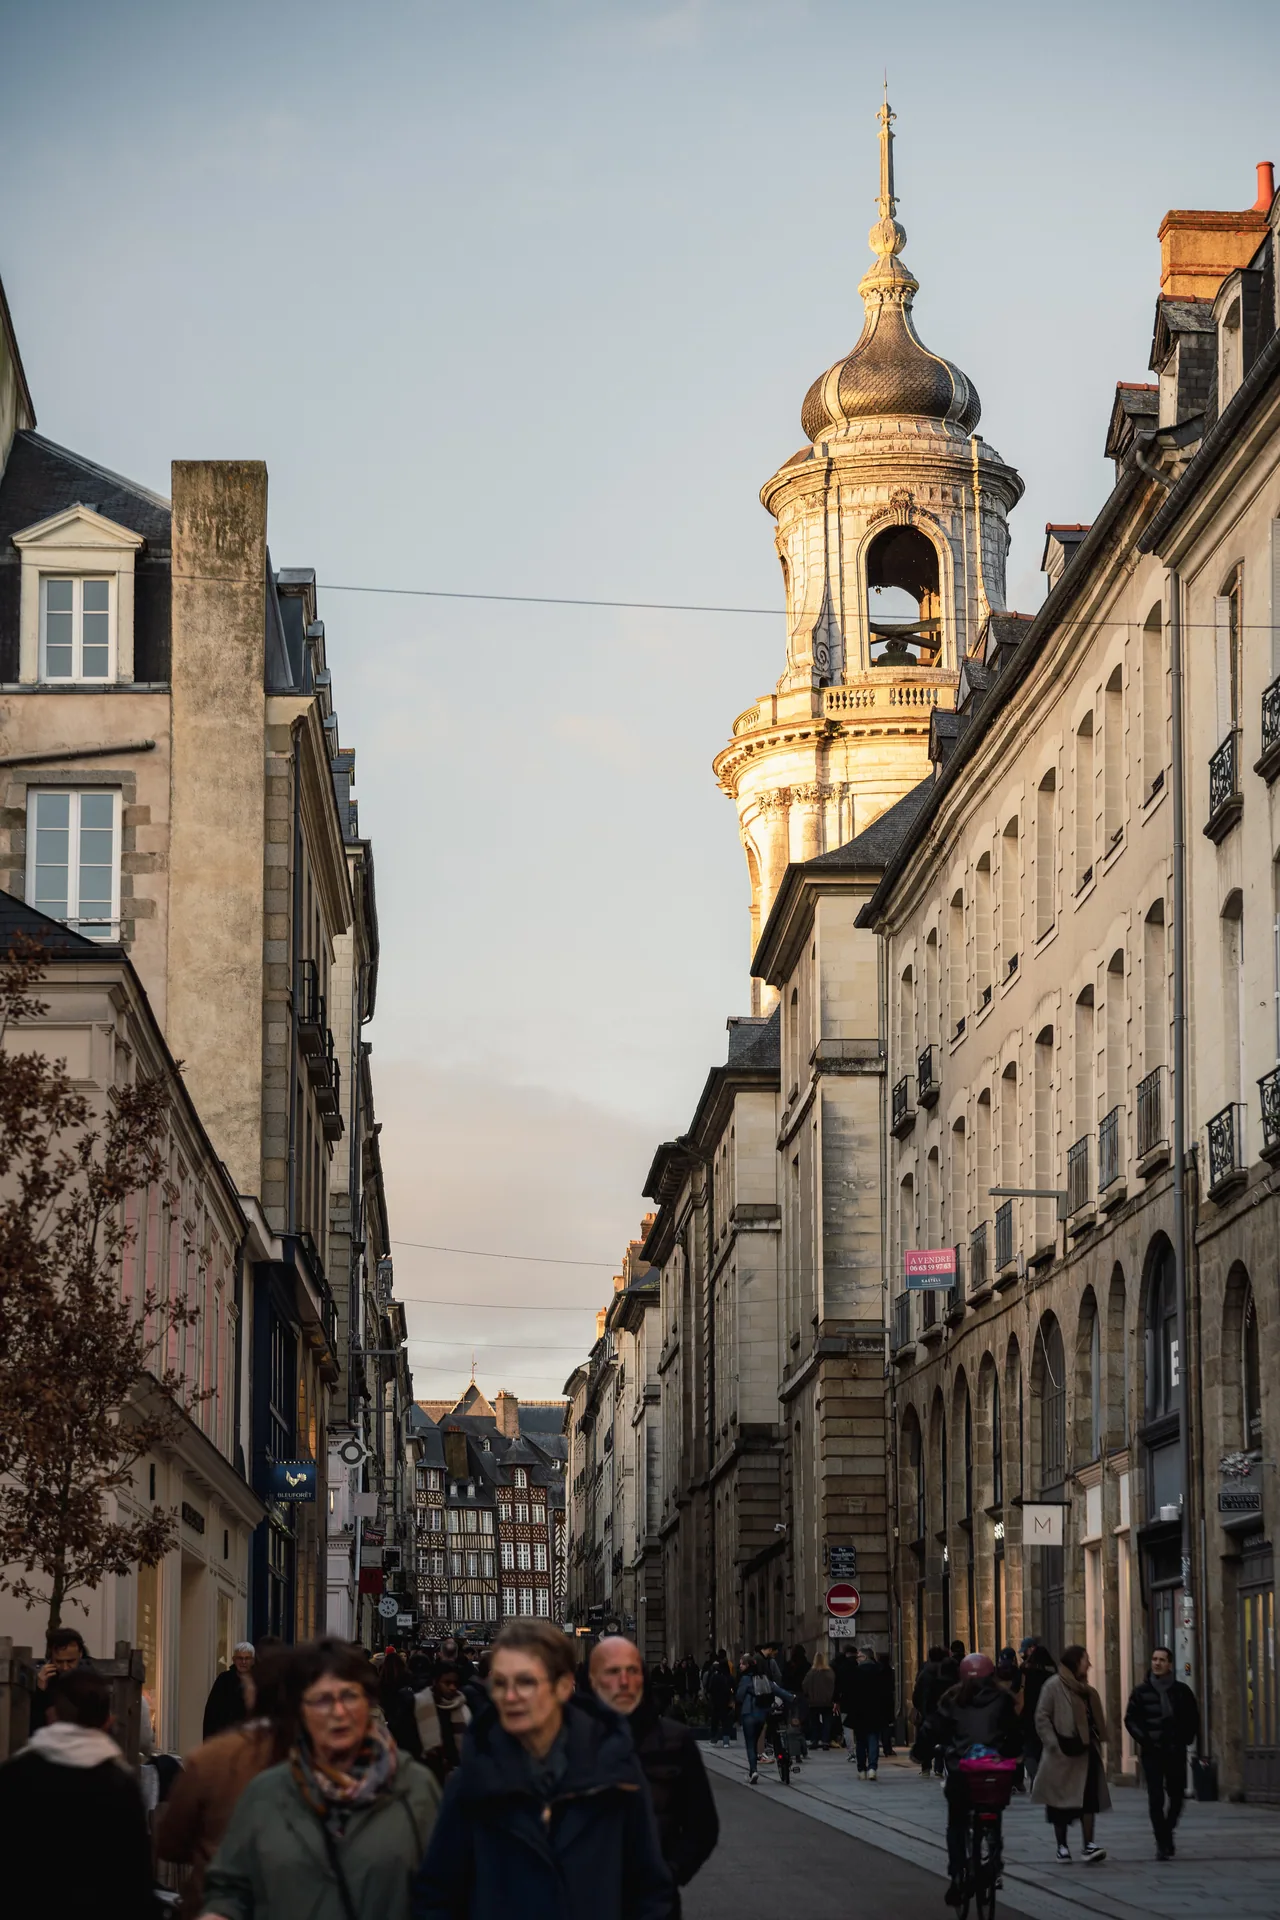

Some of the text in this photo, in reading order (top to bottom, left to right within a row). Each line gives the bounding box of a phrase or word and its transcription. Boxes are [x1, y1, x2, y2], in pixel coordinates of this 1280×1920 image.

[910, 1255, 951, 1265] A VENDRE
[1034, 1516, 1050, 1534] M
